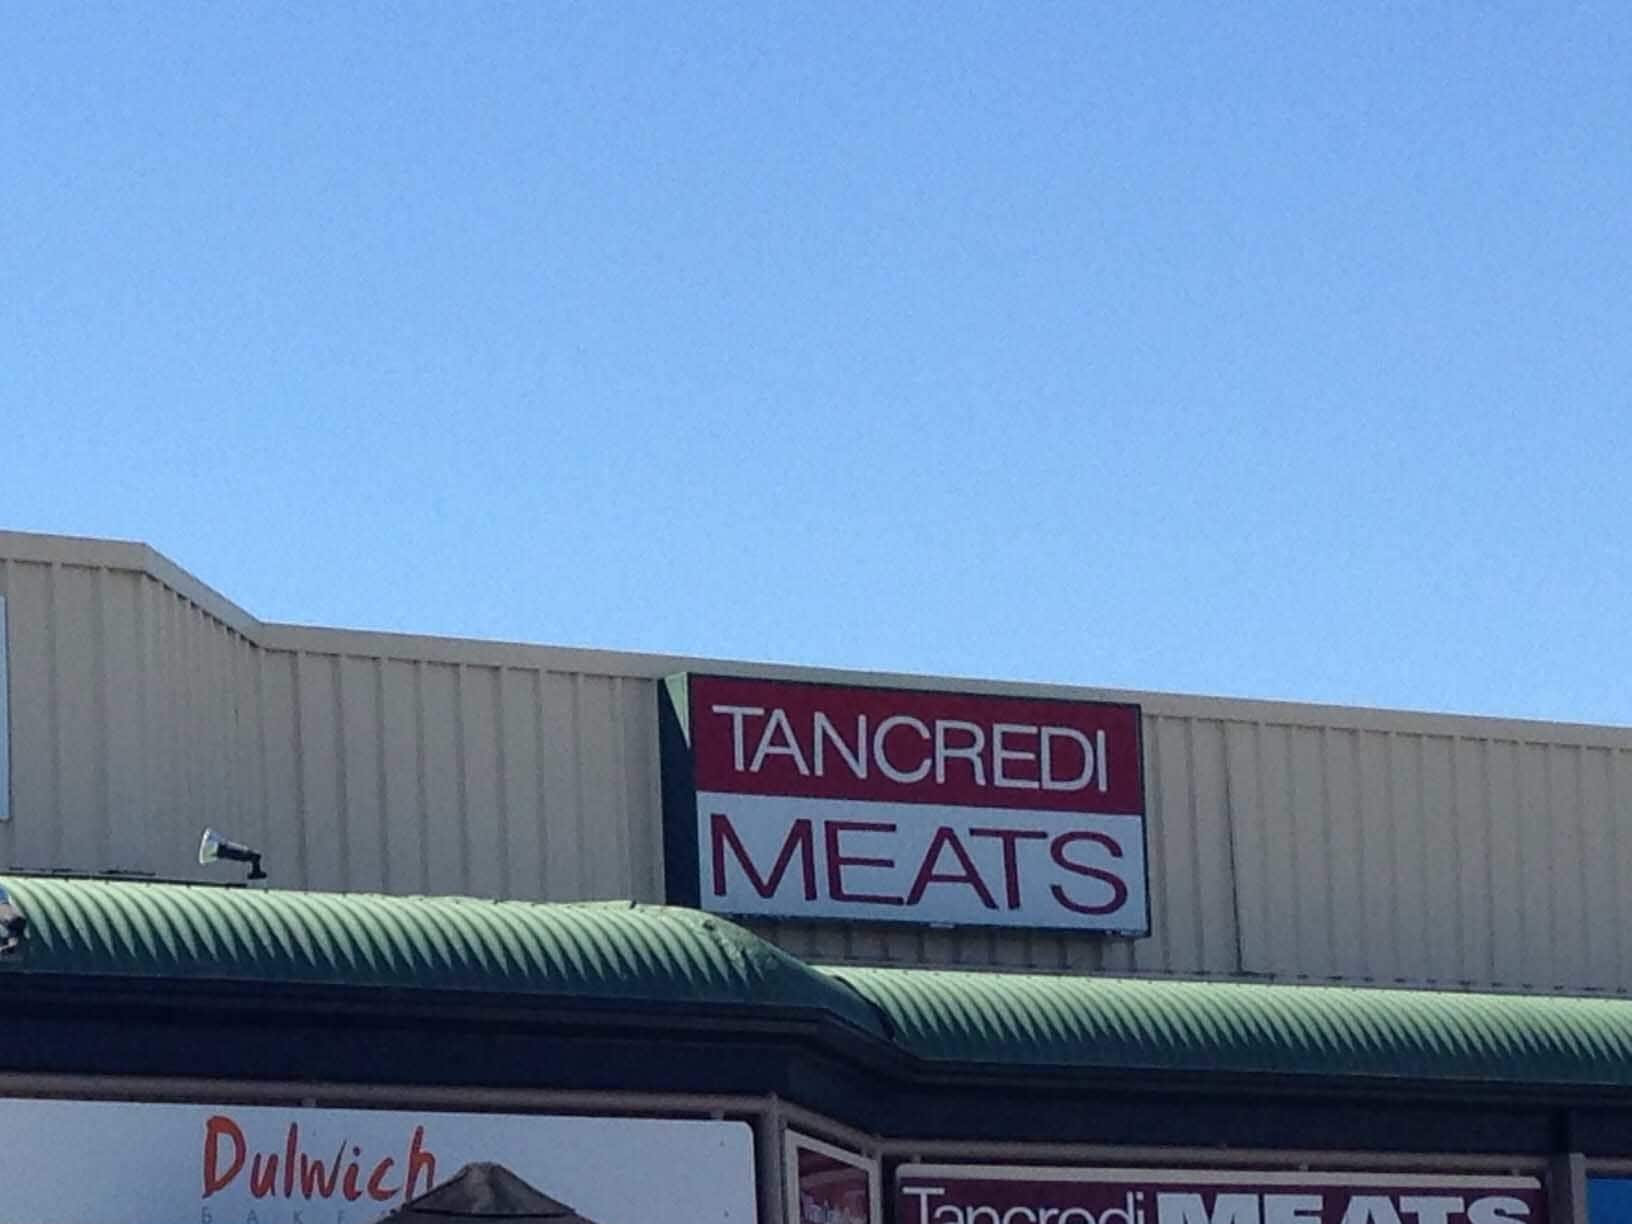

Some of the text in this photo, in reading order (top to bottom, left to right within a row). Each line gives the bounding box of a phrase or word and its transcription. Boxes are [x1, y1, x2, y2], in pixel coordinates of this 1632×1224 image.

[711, 704, 1108, 793] TANCREDI
[710, 812, 1129, 916] MEATS
[201, 1115, 436, 1202] Dulwich
